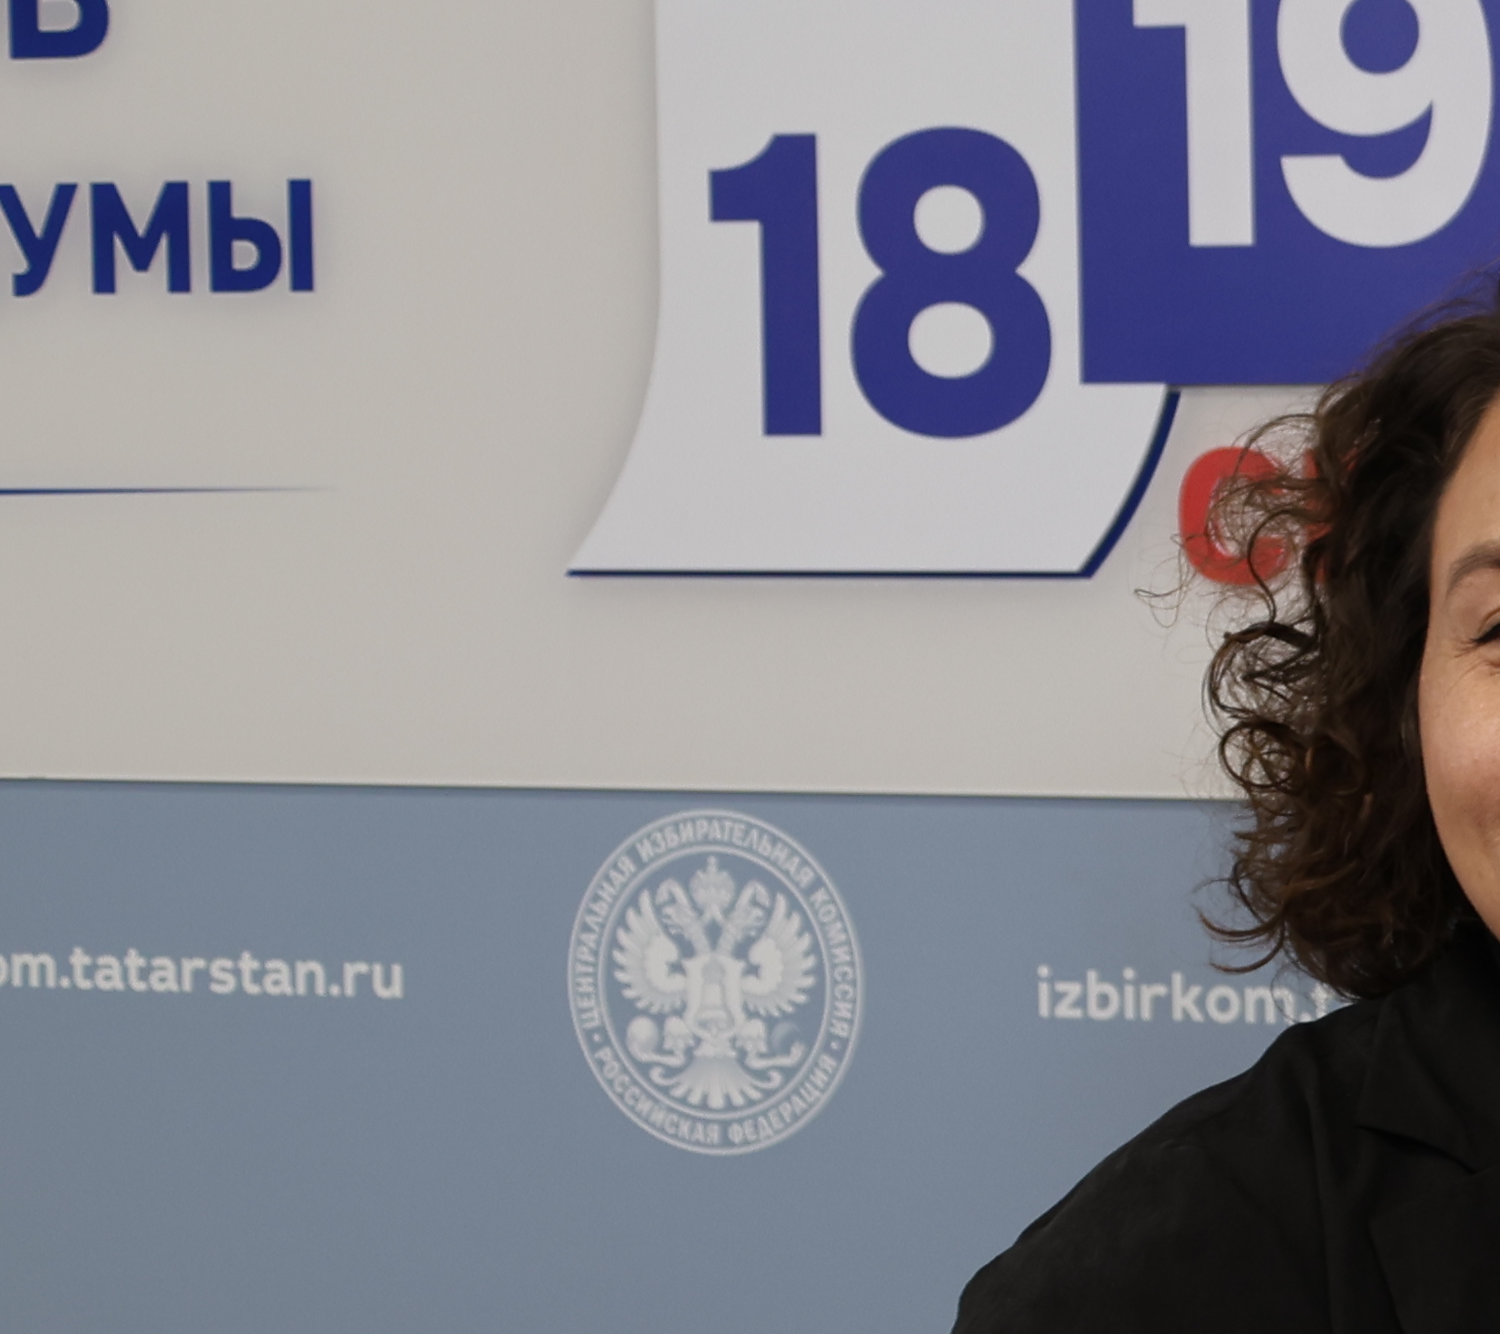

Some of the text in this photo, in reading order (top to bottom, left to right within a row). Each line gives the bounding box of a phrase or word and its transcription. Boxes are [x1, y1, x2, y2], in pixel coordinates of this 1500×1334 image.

[0, 178, 316, 297] УМЫ
[707, 126, 1054, 440] 18
[0, 946, 404, 1000] m.tatarstan.ru
